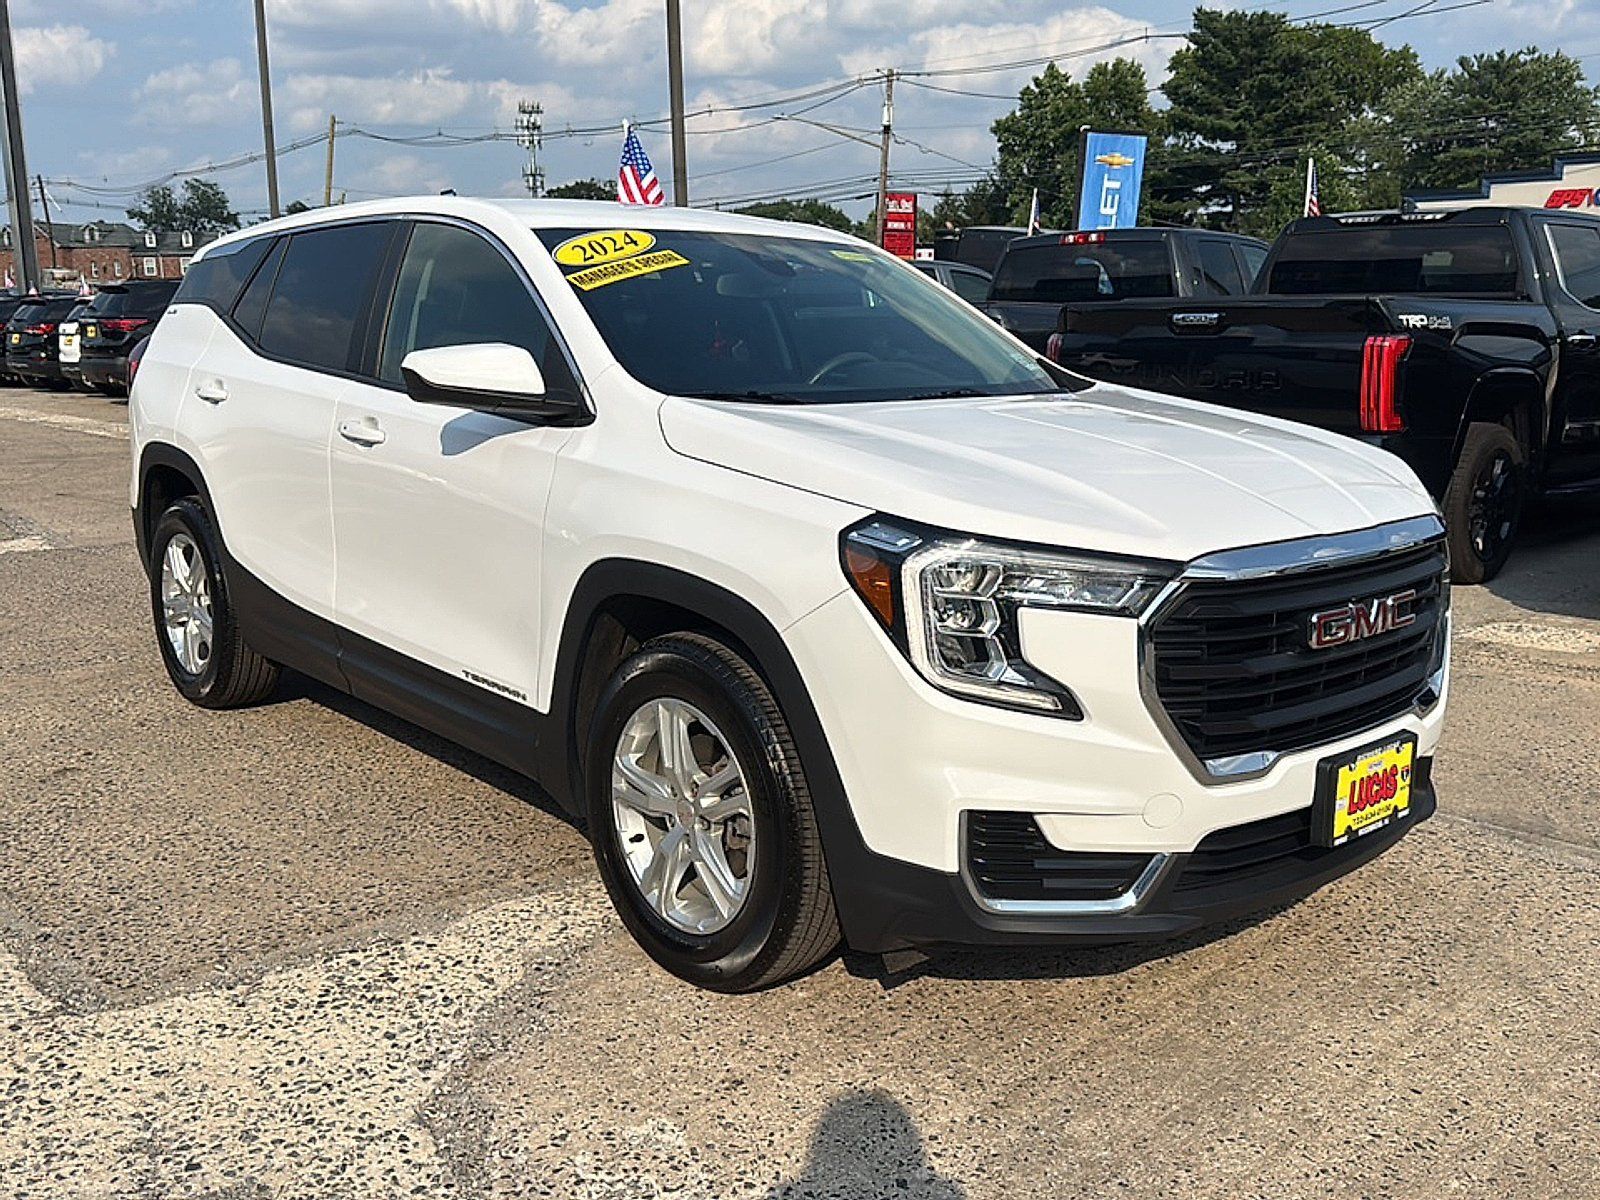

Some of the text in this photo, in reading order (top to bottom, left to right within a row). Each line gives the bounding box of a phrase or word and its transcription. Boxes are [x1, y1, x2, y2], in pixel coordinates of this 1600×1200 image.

[572, 231, 640, 261] 2024
[572, 252, 681, 286] MANAGER'S SPECIAL
[1309, 589, 1416, 650] GMC
[462, 669, 527, 701] TERRAIN
[1347, 763, 1399, 816] LUCAS
